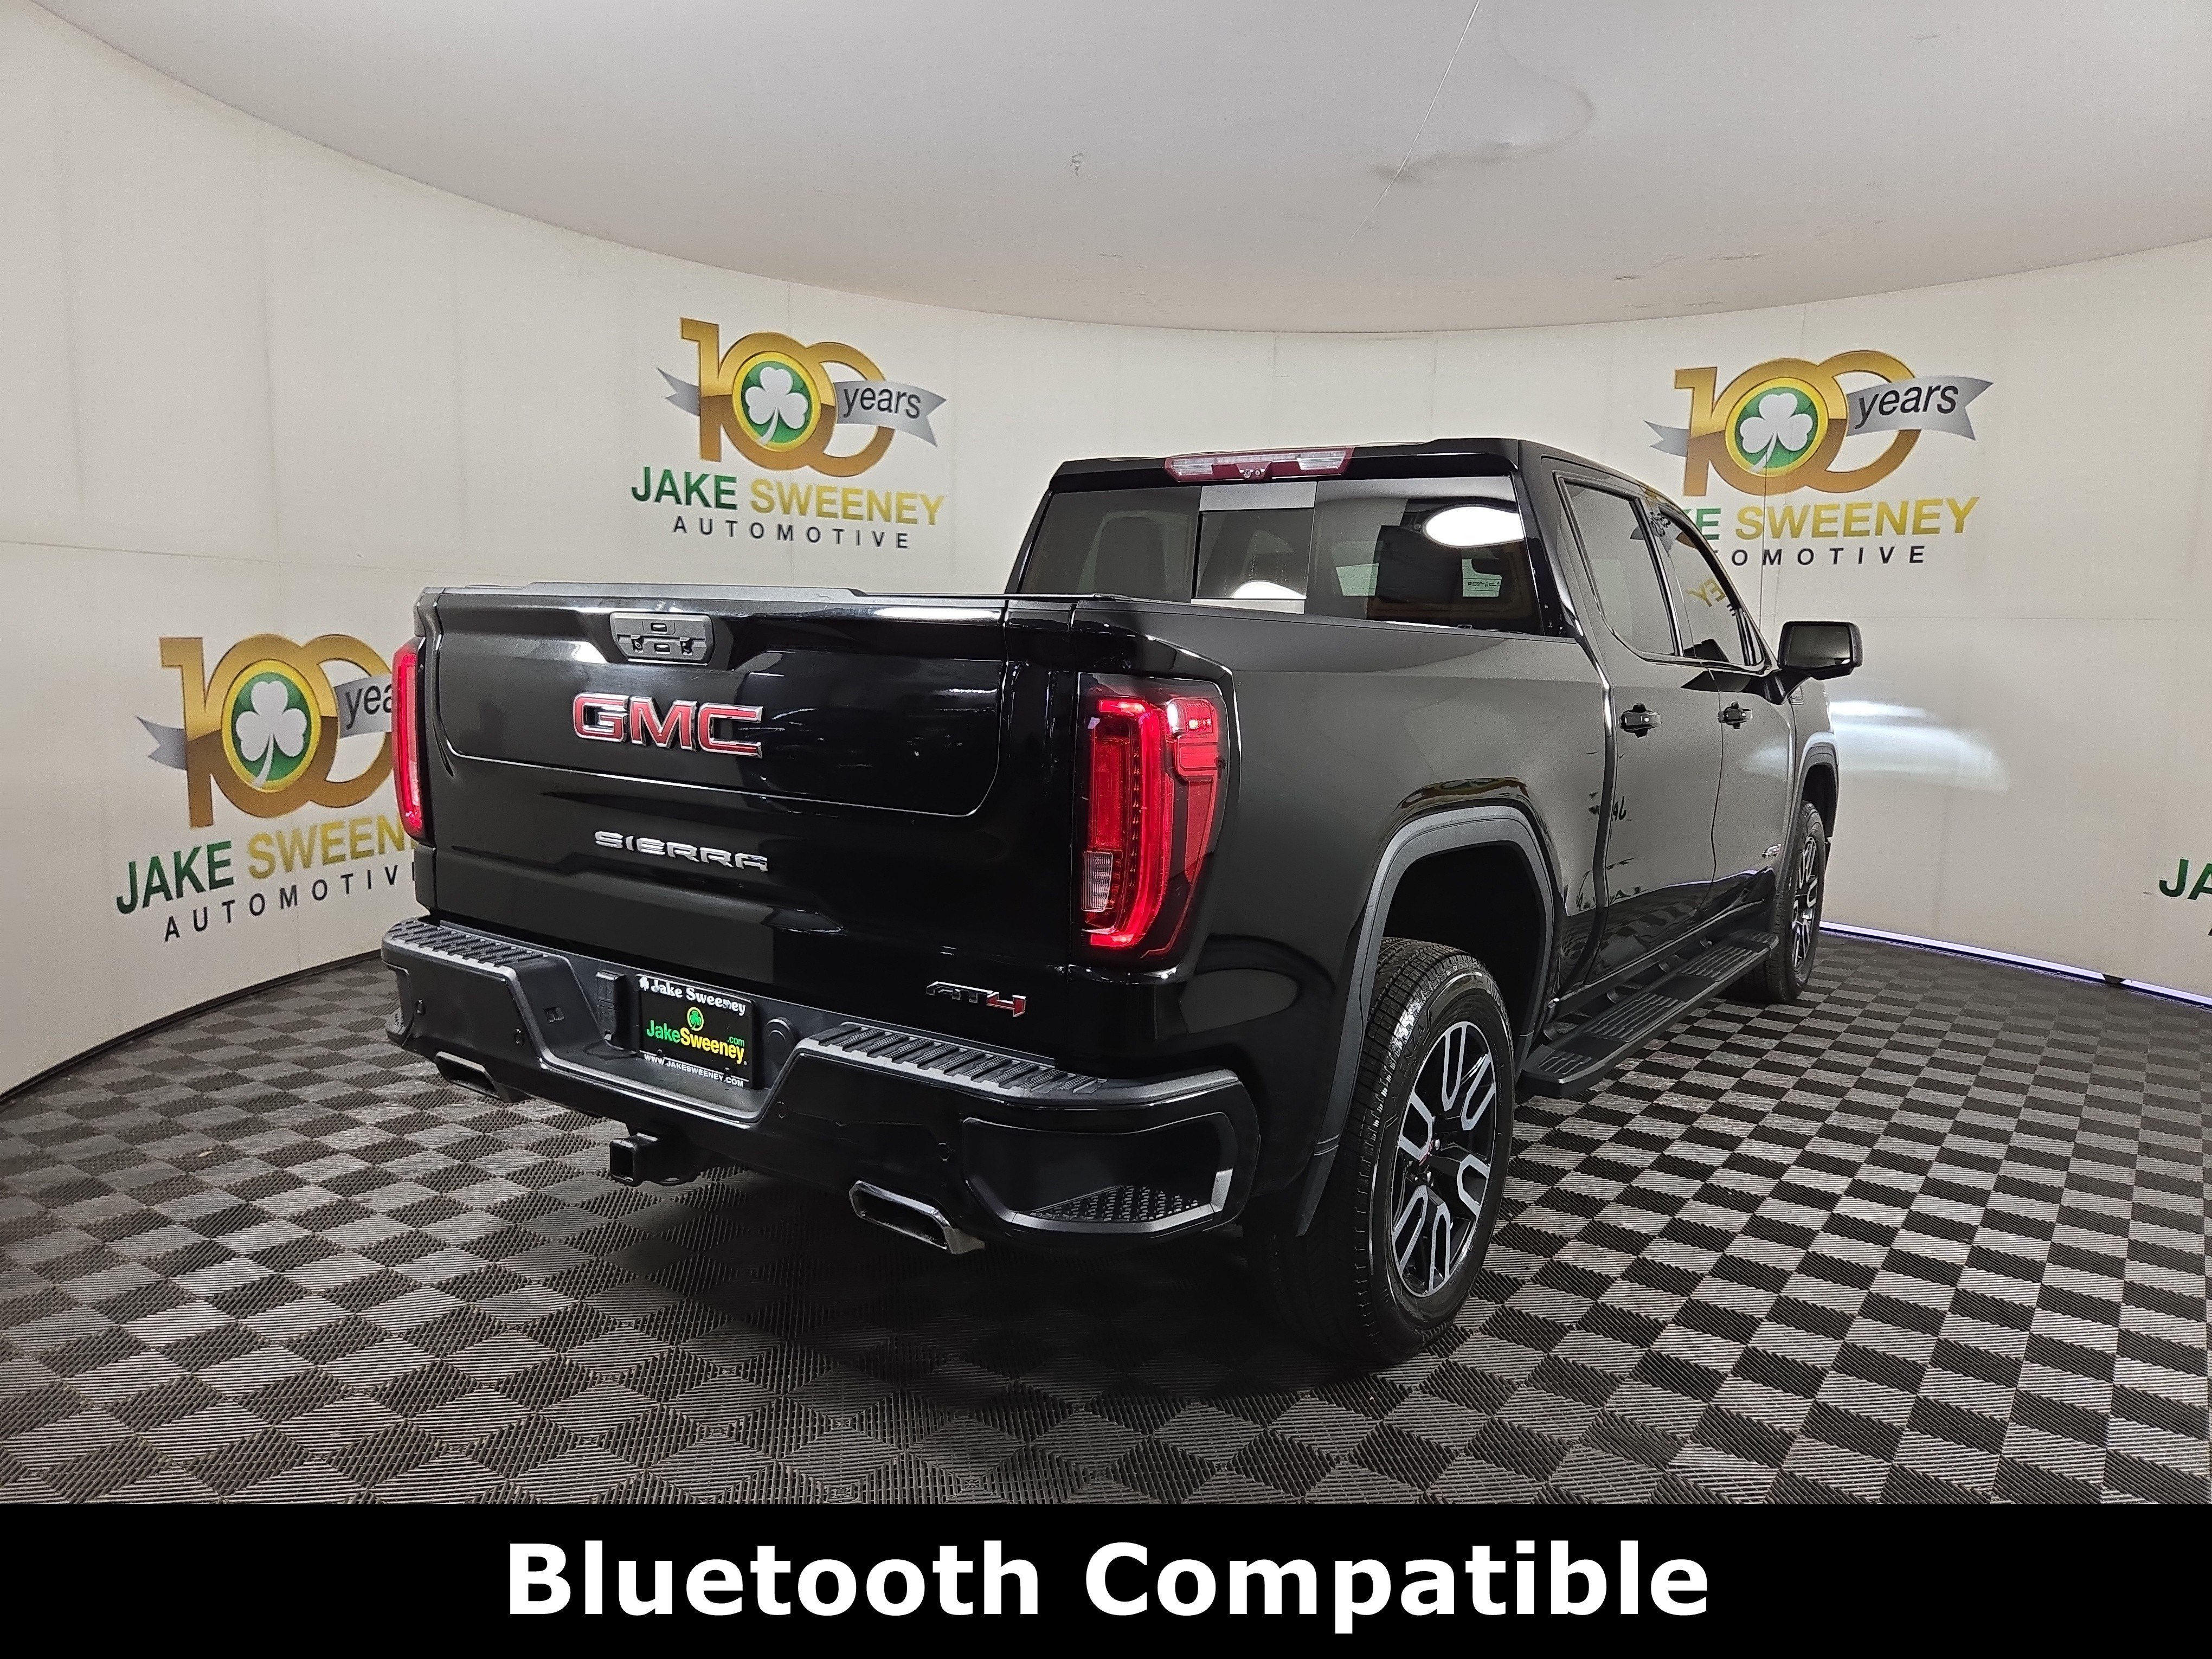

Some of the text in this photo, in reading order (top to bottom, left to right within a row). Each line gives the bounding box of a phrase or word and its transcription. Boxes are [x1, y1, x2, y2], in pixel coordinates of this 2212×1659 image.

[843, 384, 922, 420] years
[1855, 384, 1959, 429] years
[631, 466, 946, 526] JAKE SWEENEY
[672, 516, 909, 549] AUTOMOTIVE
[1735, 497, 1980, 541] SWEENEY
[1714, 545, 1926, 566] OMOTIVE
[344, 682, 393, 729] yea
[573, 692, 764, 759] GMC
[116, 814, 419, 915] JAKE SWEEN
[595, 830, 768, 872] SIERRA
[2158, 858, 2212, 900] JA
[651, 979, 746, 1017] Jake Sweeney
[925, 981, 1026, 1018] AT4
[644, 1053, 744, 1088] WWW.JAKESWEENEY.COM
